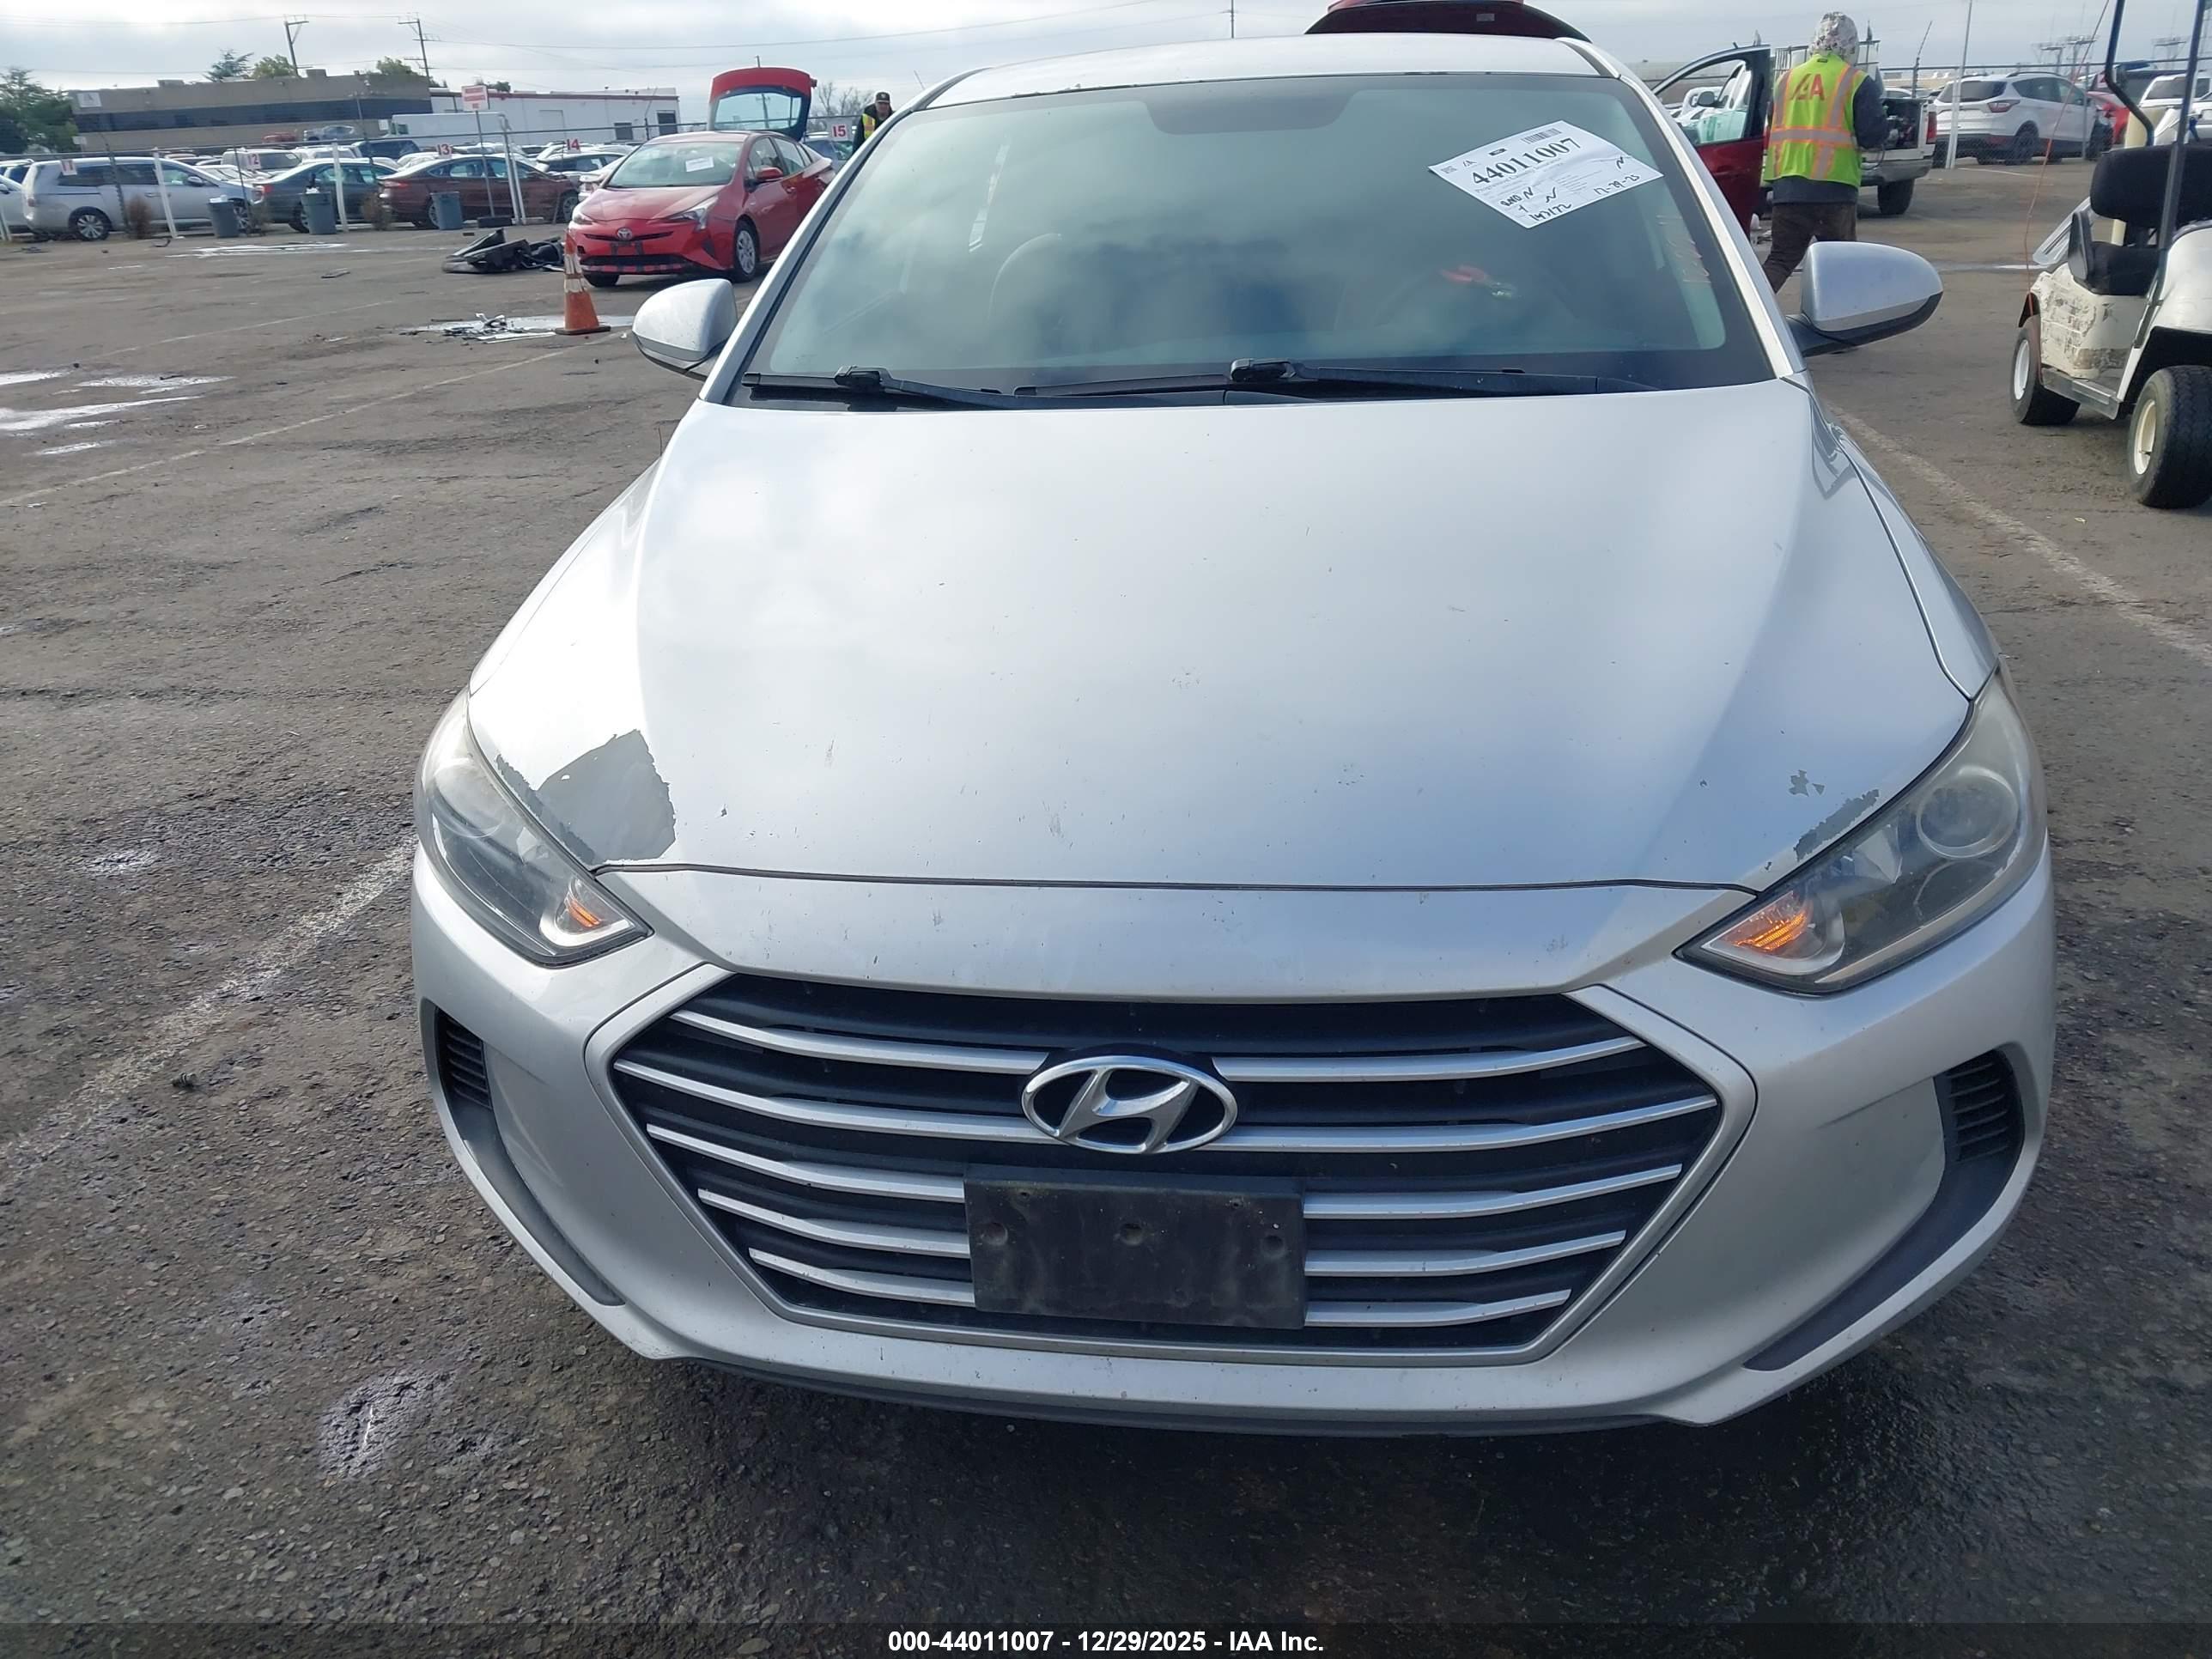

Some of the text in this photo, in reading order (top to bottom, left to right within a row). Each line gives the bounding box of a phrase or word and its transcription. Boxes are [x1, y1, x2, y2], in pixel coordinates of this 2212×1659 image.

[832, 125, 847, 137] 15
[566, 138, 580, 150] 14
[1472, 137, 1581, 185] 44011007
